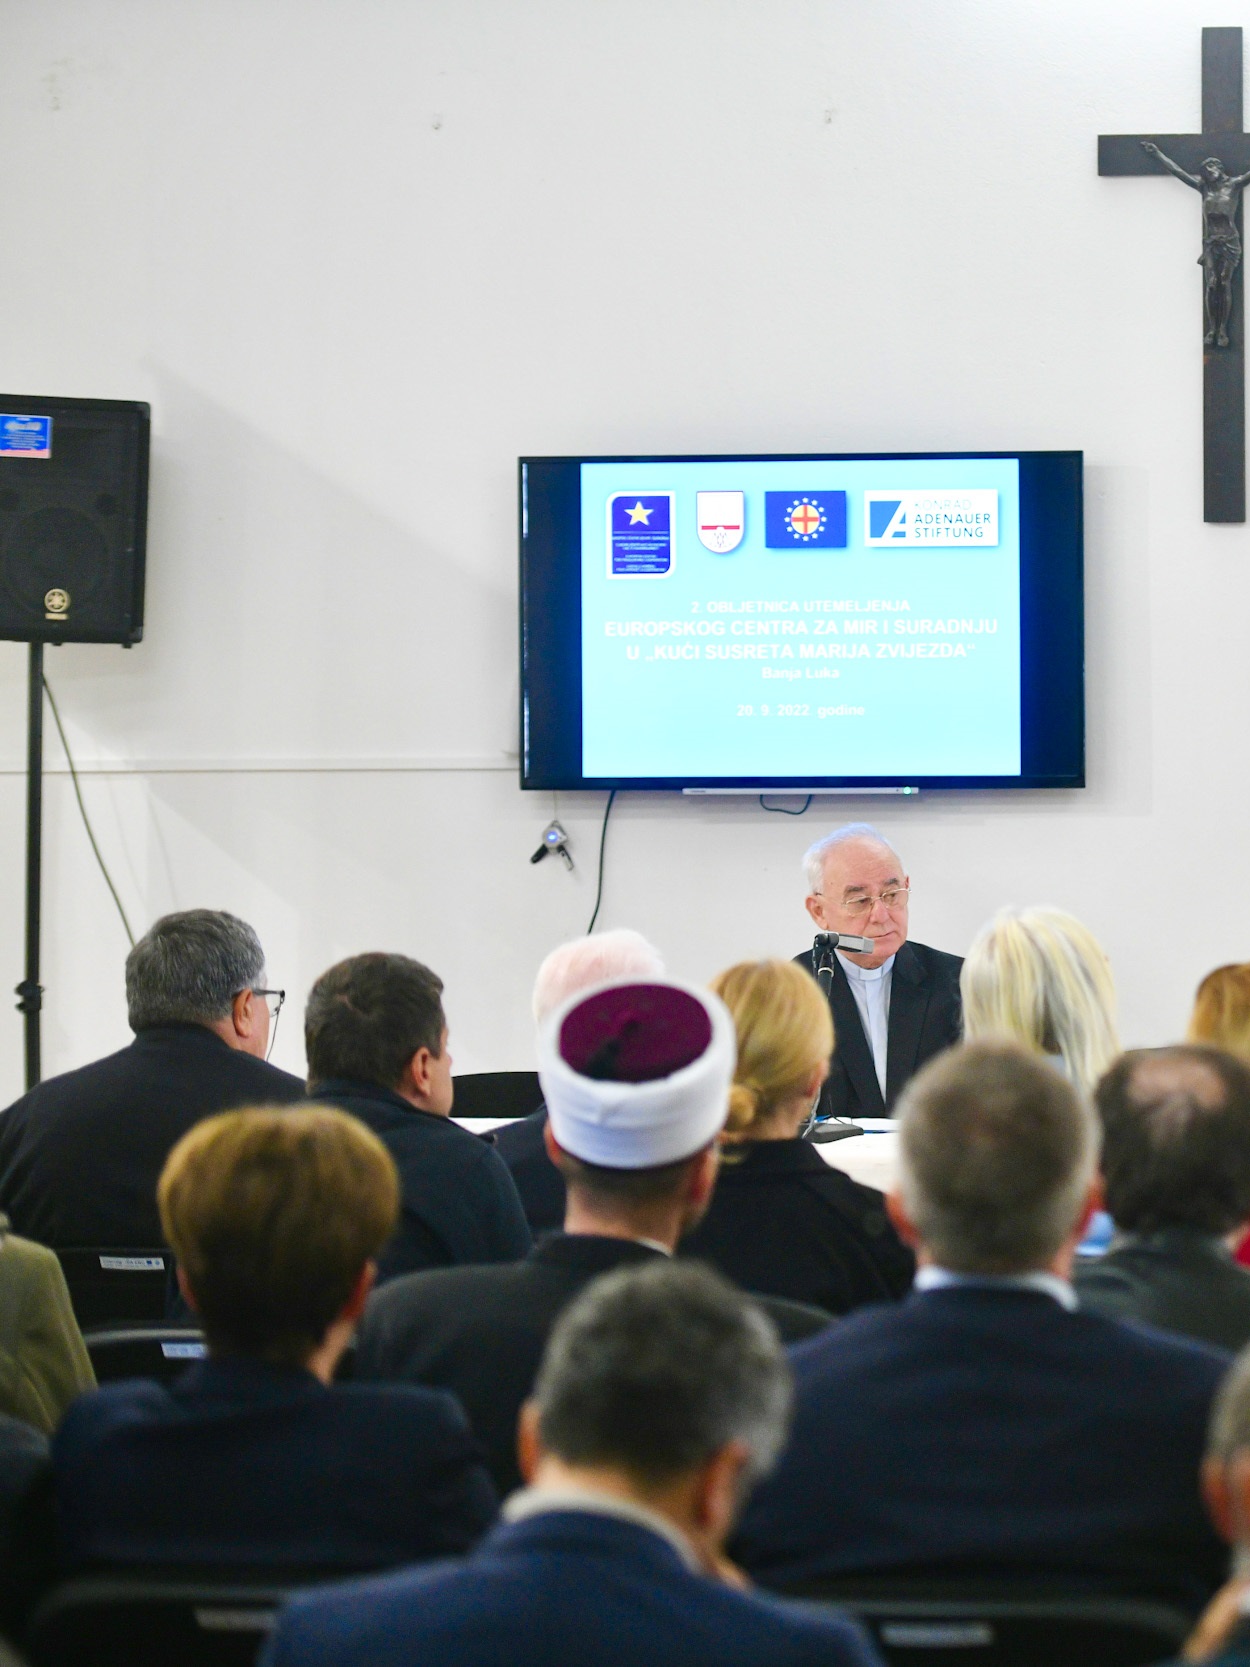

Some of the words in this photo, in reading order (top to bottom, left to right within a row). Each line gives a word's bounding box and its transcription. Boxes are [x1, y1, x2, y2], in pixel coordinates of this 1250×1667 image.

[914, 500, 972, 510] KONRAD
[914, 513, 991, 524] ADENAUER
[914, 527, 984, 538] STIFTUNG
[706, 600, 799, 613] OBLJETNICA
[803, 599, 911, 613] UTEMELJENJA
[604, 620, 725, 637] EUROPSKOG
[730, 620, 808, 636] CENTRA
[813, 619, 839, 635] ZA
[843, 619, 878, 635] MIR
[882, 619, 889, 635] I
[893, 617, 998, 635] SURADNJU
[626, 645, 641, 660] U
[704, 643, 795, 660] SUSRETA
[799, 643, 872, 659] MARIJA
[761, 666, 802, 682] Banja
[805, 666, 840, 680] Luka
[736, 704, 757, 717] 20.
[817, 703, 866, 719] godine
